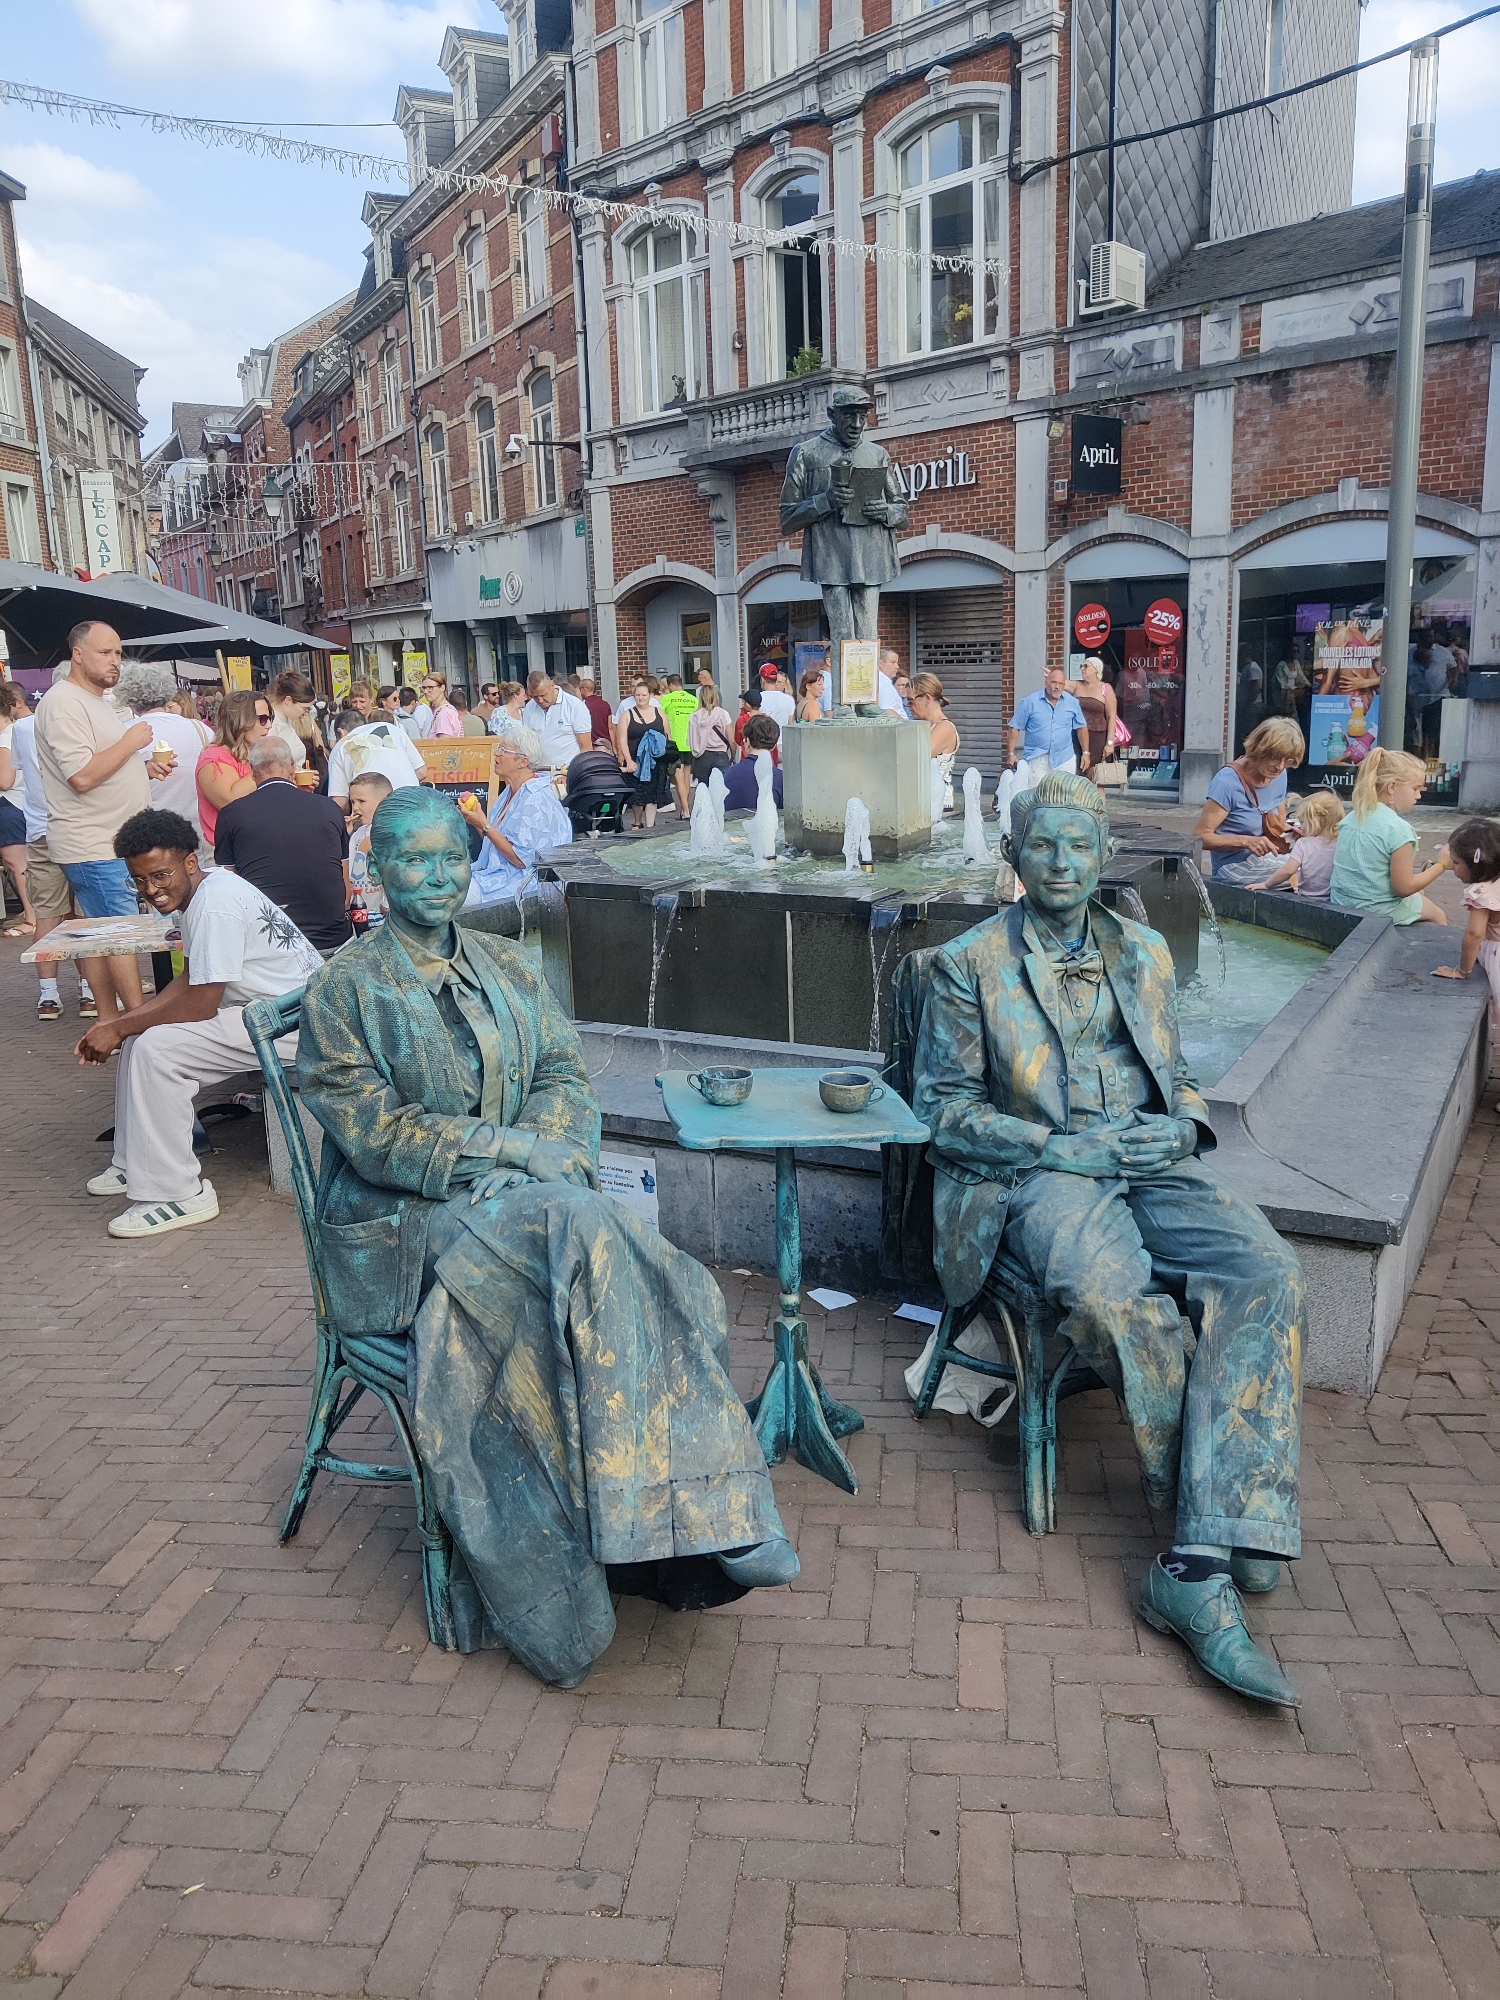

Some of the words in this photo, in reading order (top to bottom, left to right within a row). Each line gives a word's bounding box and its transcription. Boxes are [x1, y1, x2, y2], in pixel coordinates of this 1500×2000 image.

[92, 490, 107, 519] LE
[1148, 609, 1180, 631] -25%
[1318, 646, 1353, 658] NOUVELLES
[1354, 646, 1381, 658] LOTIONS
[1323, 657, 1340, 669] BODY
